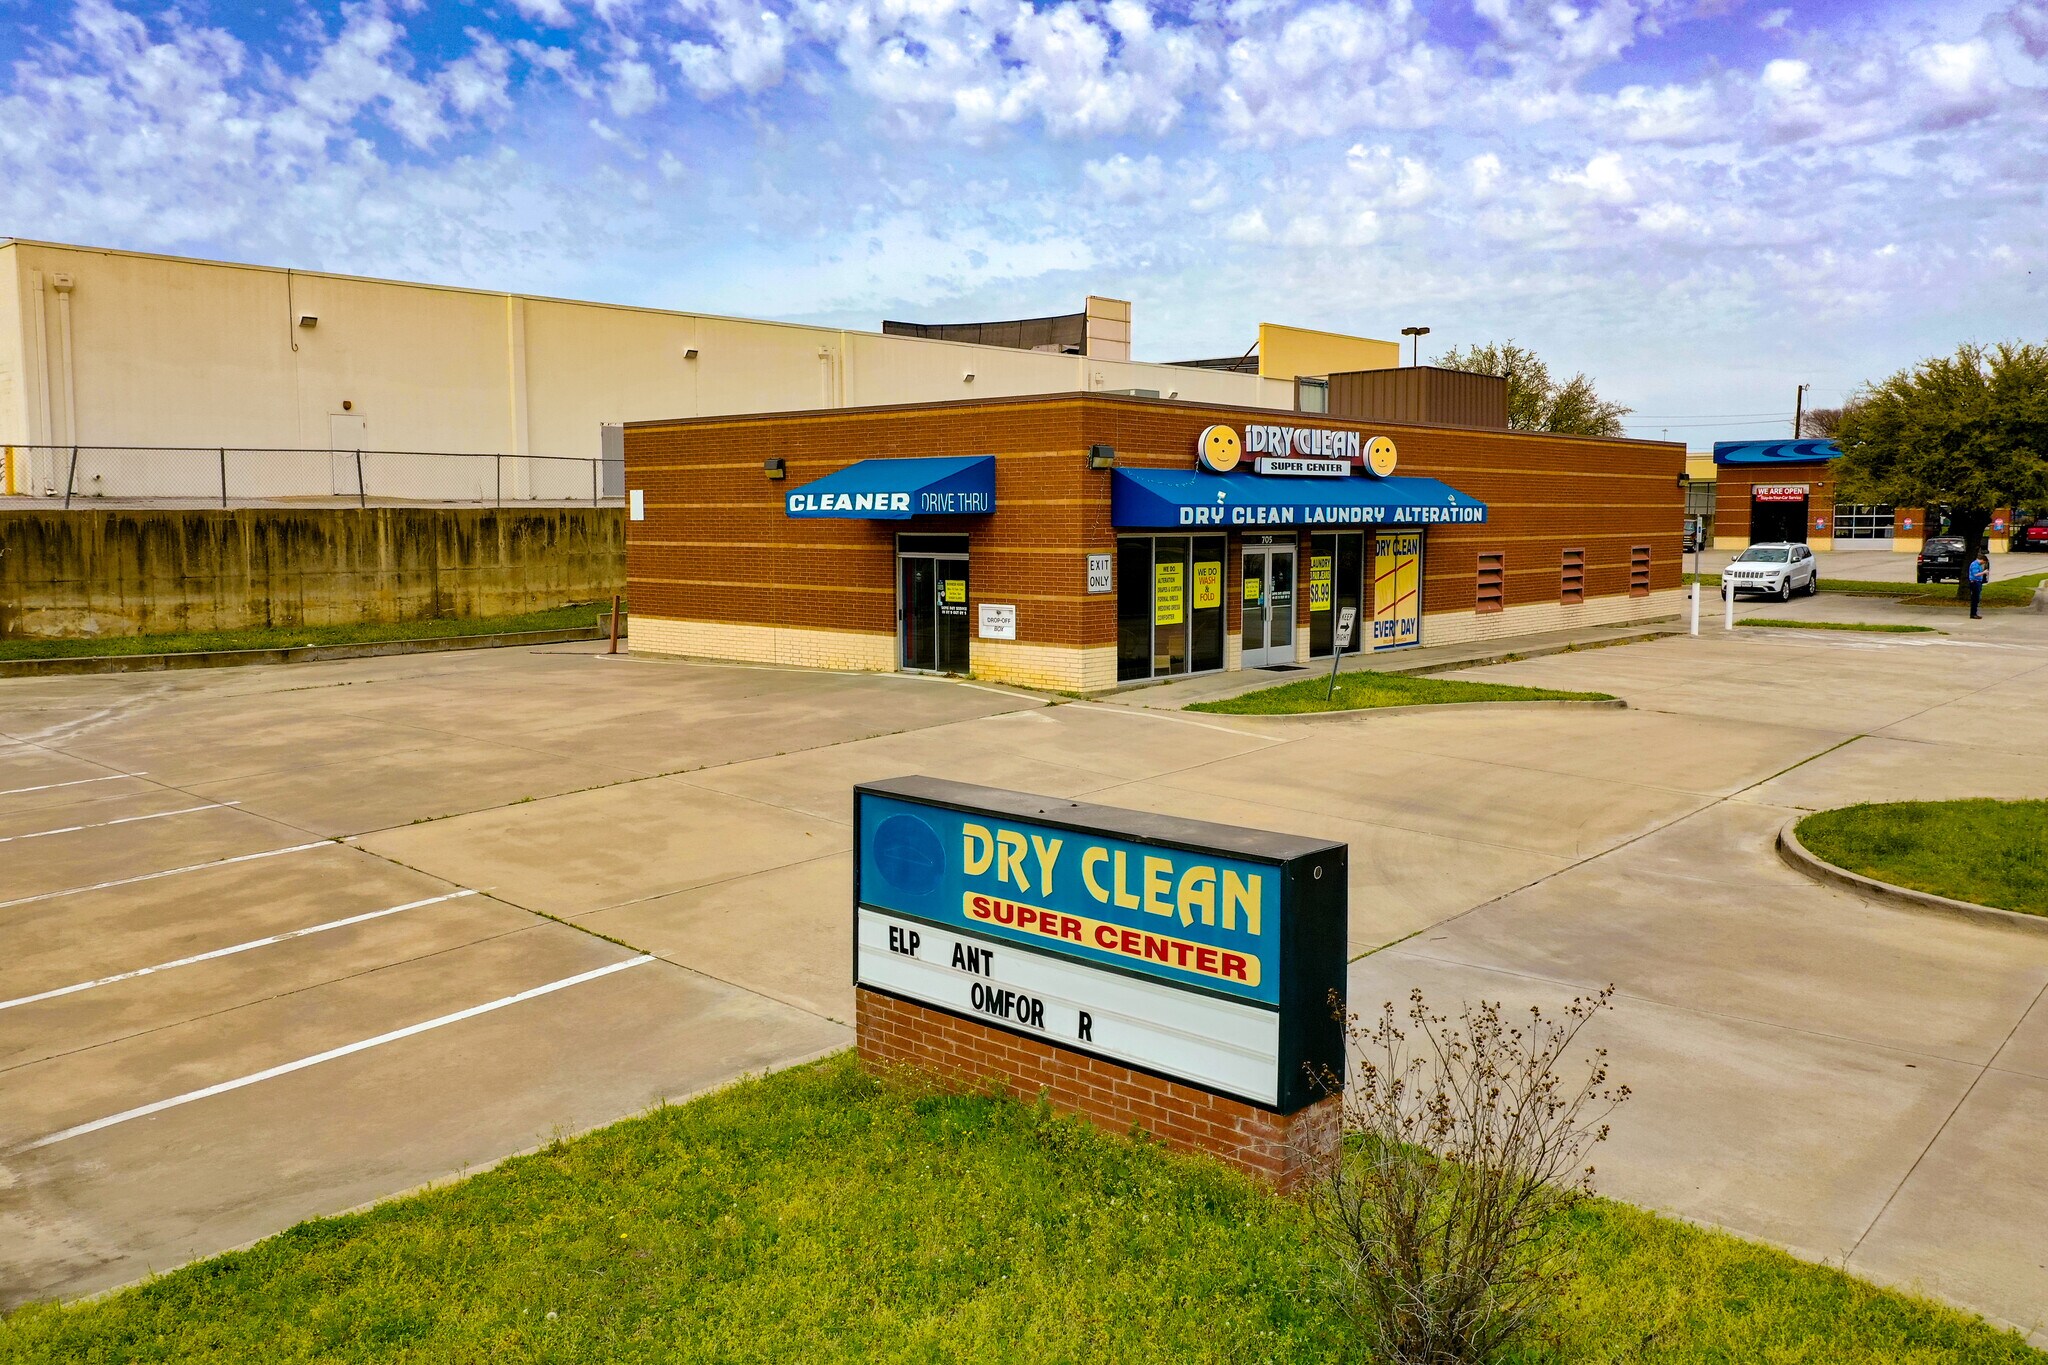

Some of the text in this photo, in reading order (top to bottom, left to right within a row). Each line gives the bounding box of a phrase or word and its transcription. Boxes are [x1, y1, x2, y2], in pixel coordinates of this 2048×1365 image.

[1294, 429, 1360, 459] CLEAN
[1270, 461, 1343, 473] SUPER CENTER
[1758, 487, 1803, 495] WE ARE OPEN
[789, 492, 910, 512] CLEANER
[921, 492, 988, 512] DRIVE THRU
[1179, 506, 1483, 525] DRY CLEAN LAUNDRY ALTERATION
[1261, 535, 1273, 544] 705
[1376, 539, 1417, 556] DRY CLEAN
[1090, 559, 1109, 571] EXIT
[1198, 567, 1217, 576] WE DO
[1089, 575, 1110, 587] ONLY
[1199, 576, 1216, 585] WASH
[1204, 585, 1210, 593] &
[1199, 592, 1215, 602] FOLD
[1310, 583, 1330, 603] $8.99
[1401, 618, 1415, 635] DAY
[1336, 633, 1350, 641] RIGHT
[962, 822, 1262, 936] DRY CLEAN
[972, 896, 1248, 981] SUPER CENTER
[889, 925, 994, 977] ELP ANT
[970, 982, 1093, 1043] OMFOR R
